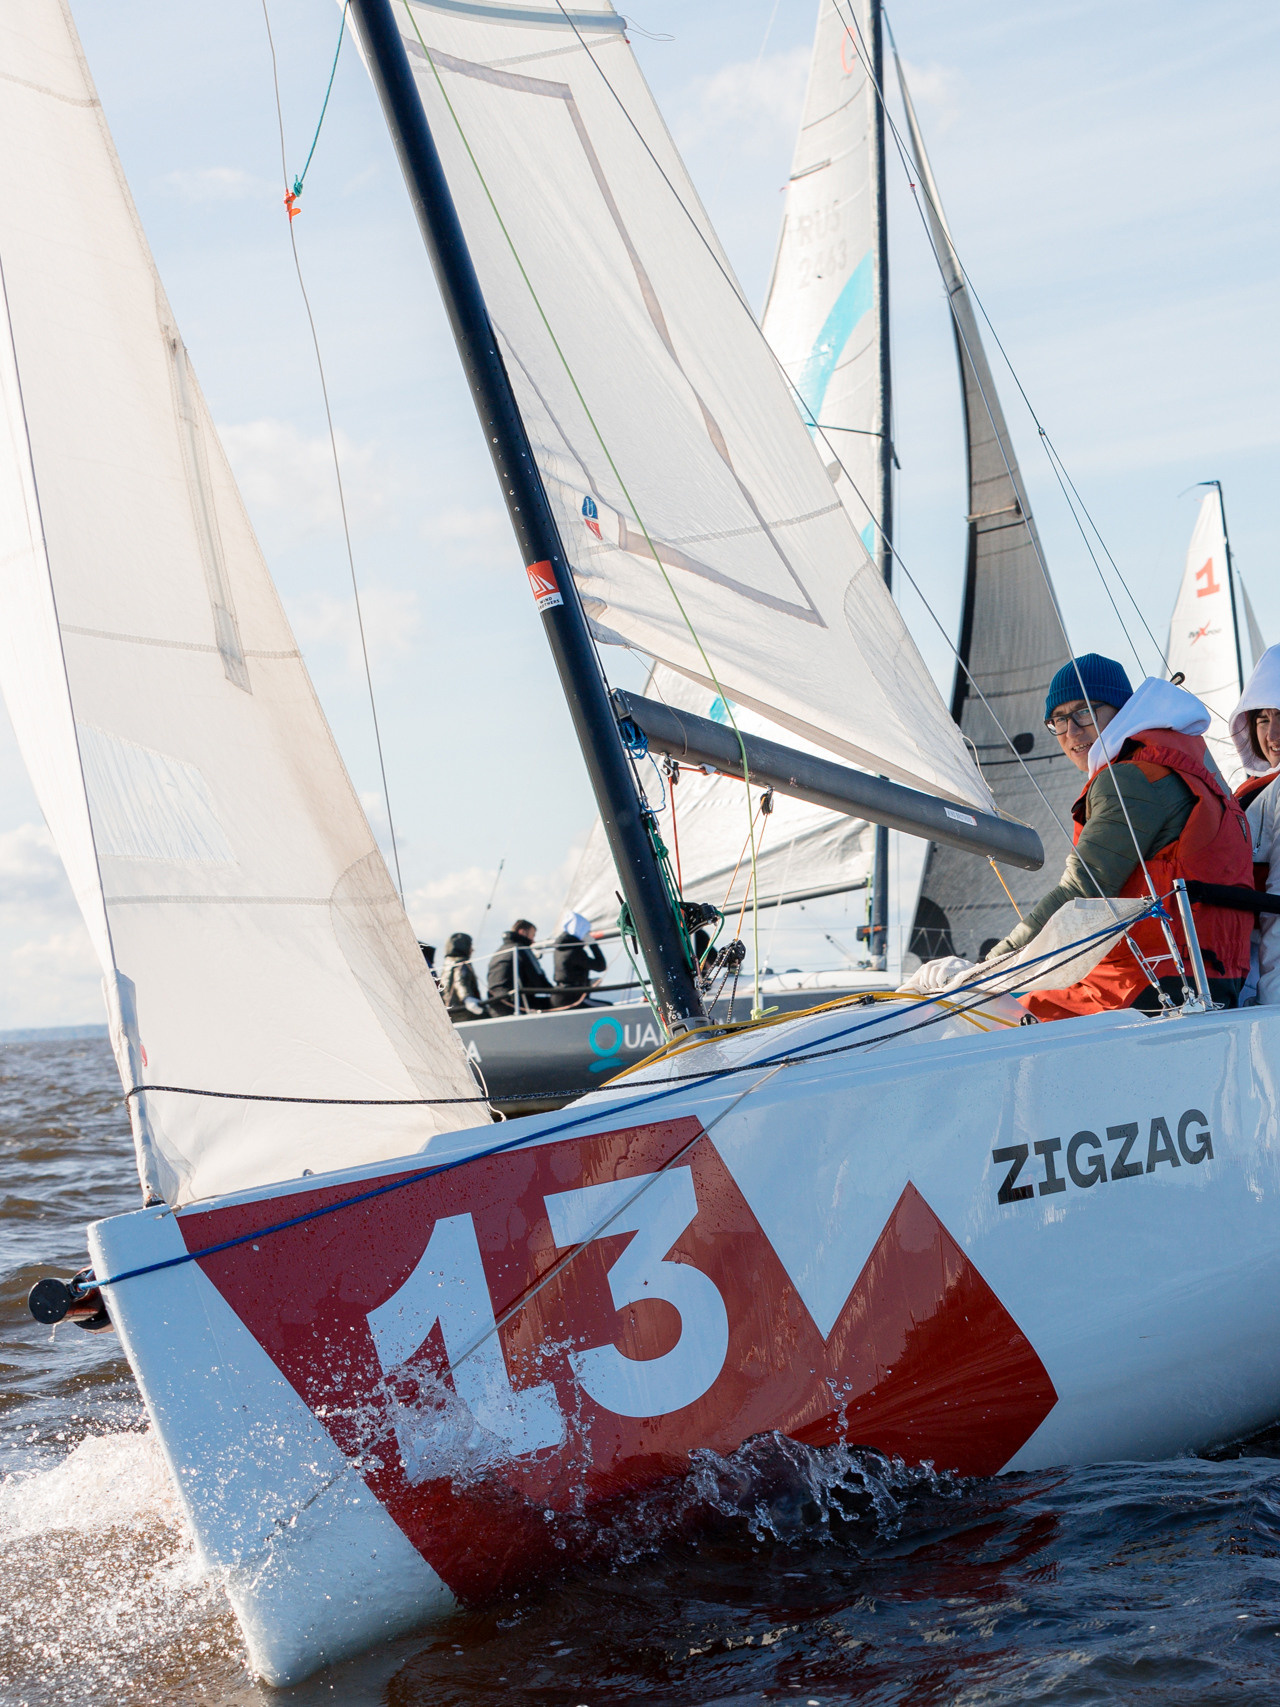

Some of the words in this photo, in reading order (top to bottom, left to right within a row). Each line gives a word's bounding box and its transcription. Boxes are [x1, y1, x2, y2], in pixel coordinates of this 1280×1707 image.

[1195, 556, 1221, 598] 1
[991, 1108, 1215, 1206] ZIGZAG
[365, 1164, 730, 1486] 13
